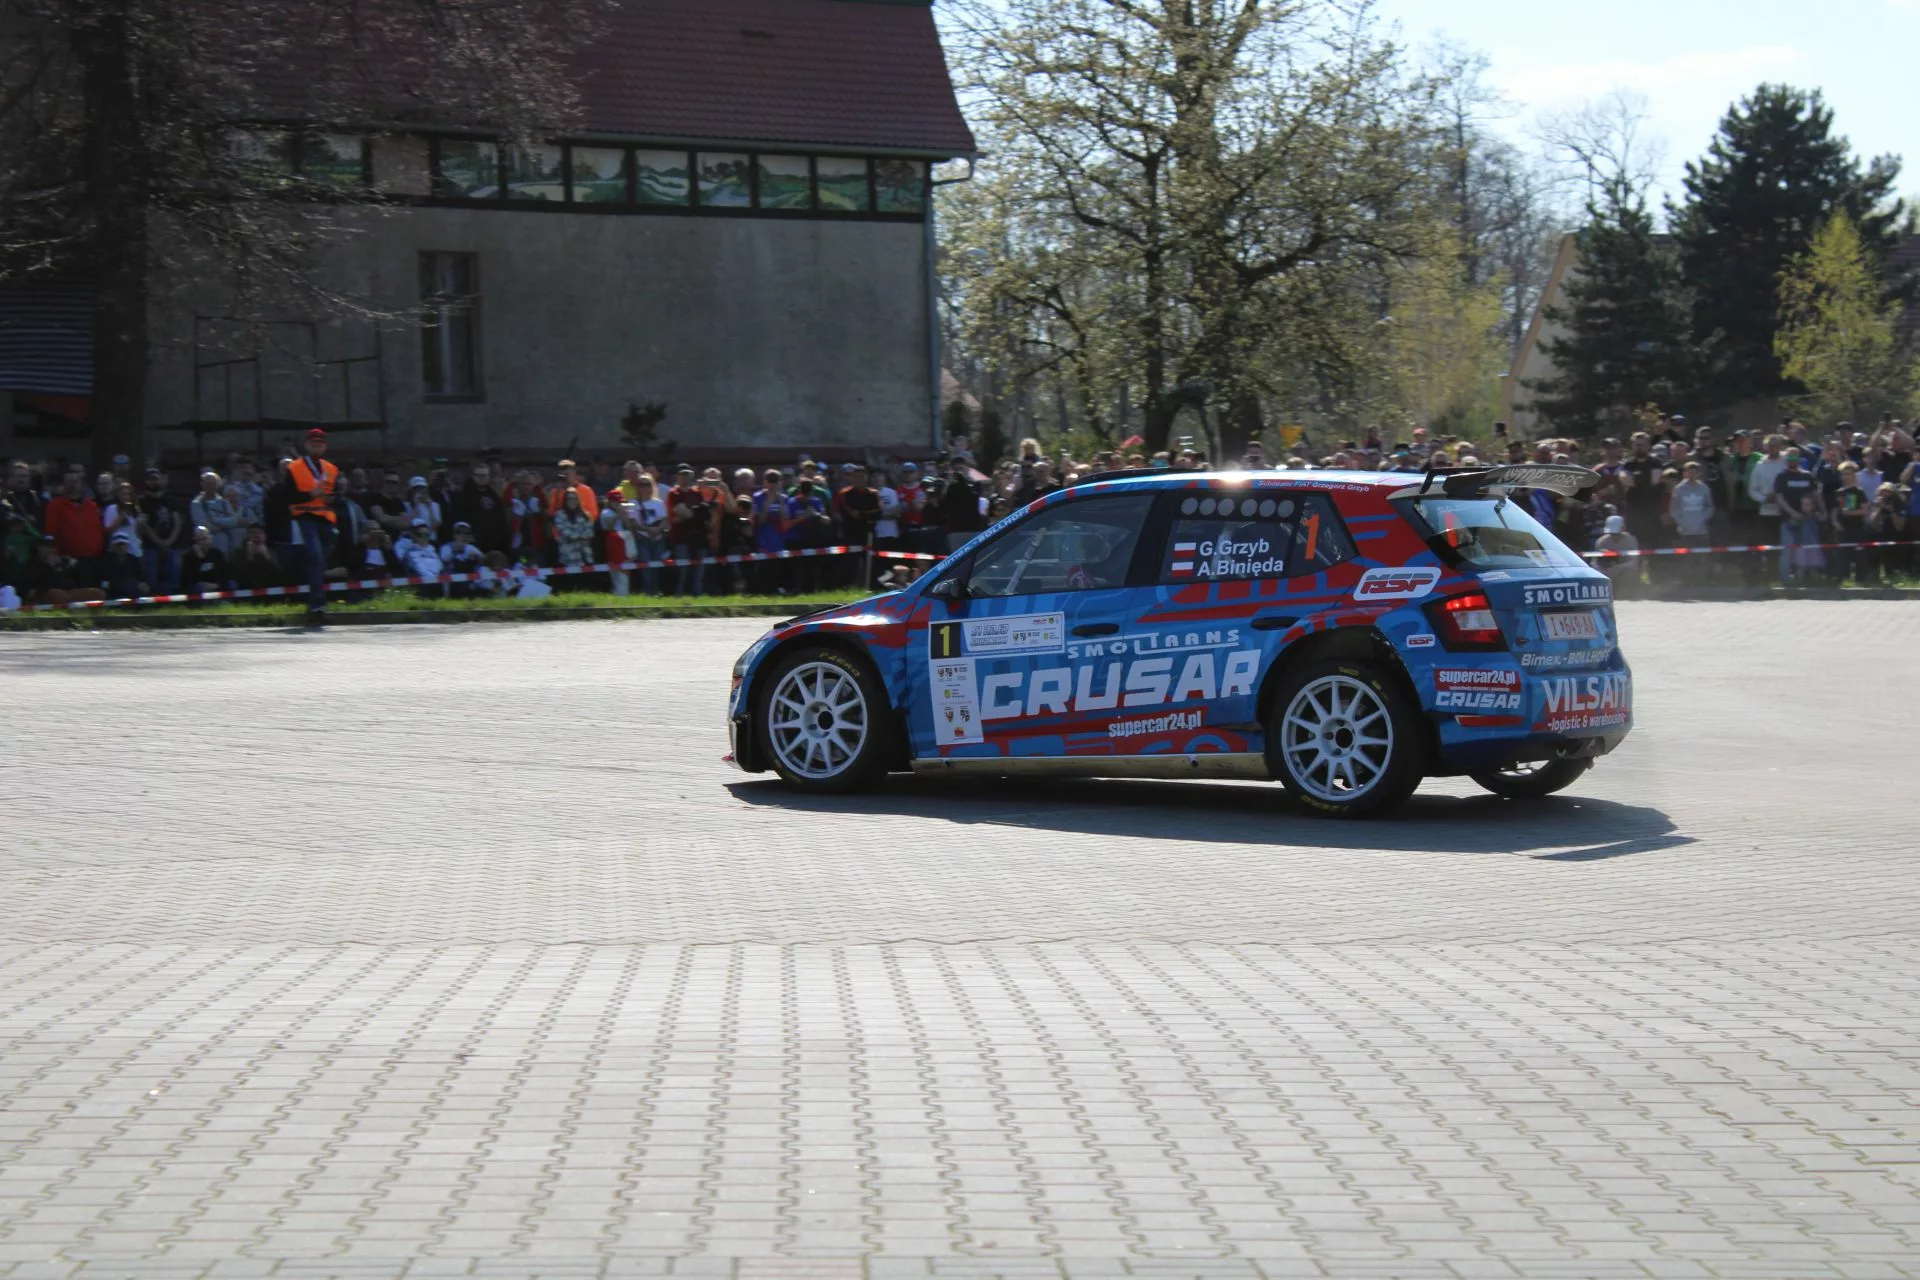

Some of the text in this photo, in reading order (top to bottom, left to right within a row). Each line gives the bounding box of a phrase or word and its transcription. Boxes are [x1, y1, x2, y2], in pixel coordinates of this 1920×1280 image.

[1312, 481, 1346, 490] Grzegorz
[1347, 484, 1370, 492] Grzyb
[1303, 513, 1320, 560] 1
[1200, 538, 1270, 557] G.Grzyb
[1197, 557, 1284, 577] A.Binięda
[1361, 573, 1434, 594] MSP
[940, 625, 950, 656] 1
[1067, 629, 1240, 660] SMOLTRANS
[980, 649, 1262, 721] CRUSAR
[1439, 670, 1516, 685] supercar24.pl
[1435, 691, 1521, 709] CRUSAR
[1108, 711, 1202, 738] supercar24.pl
